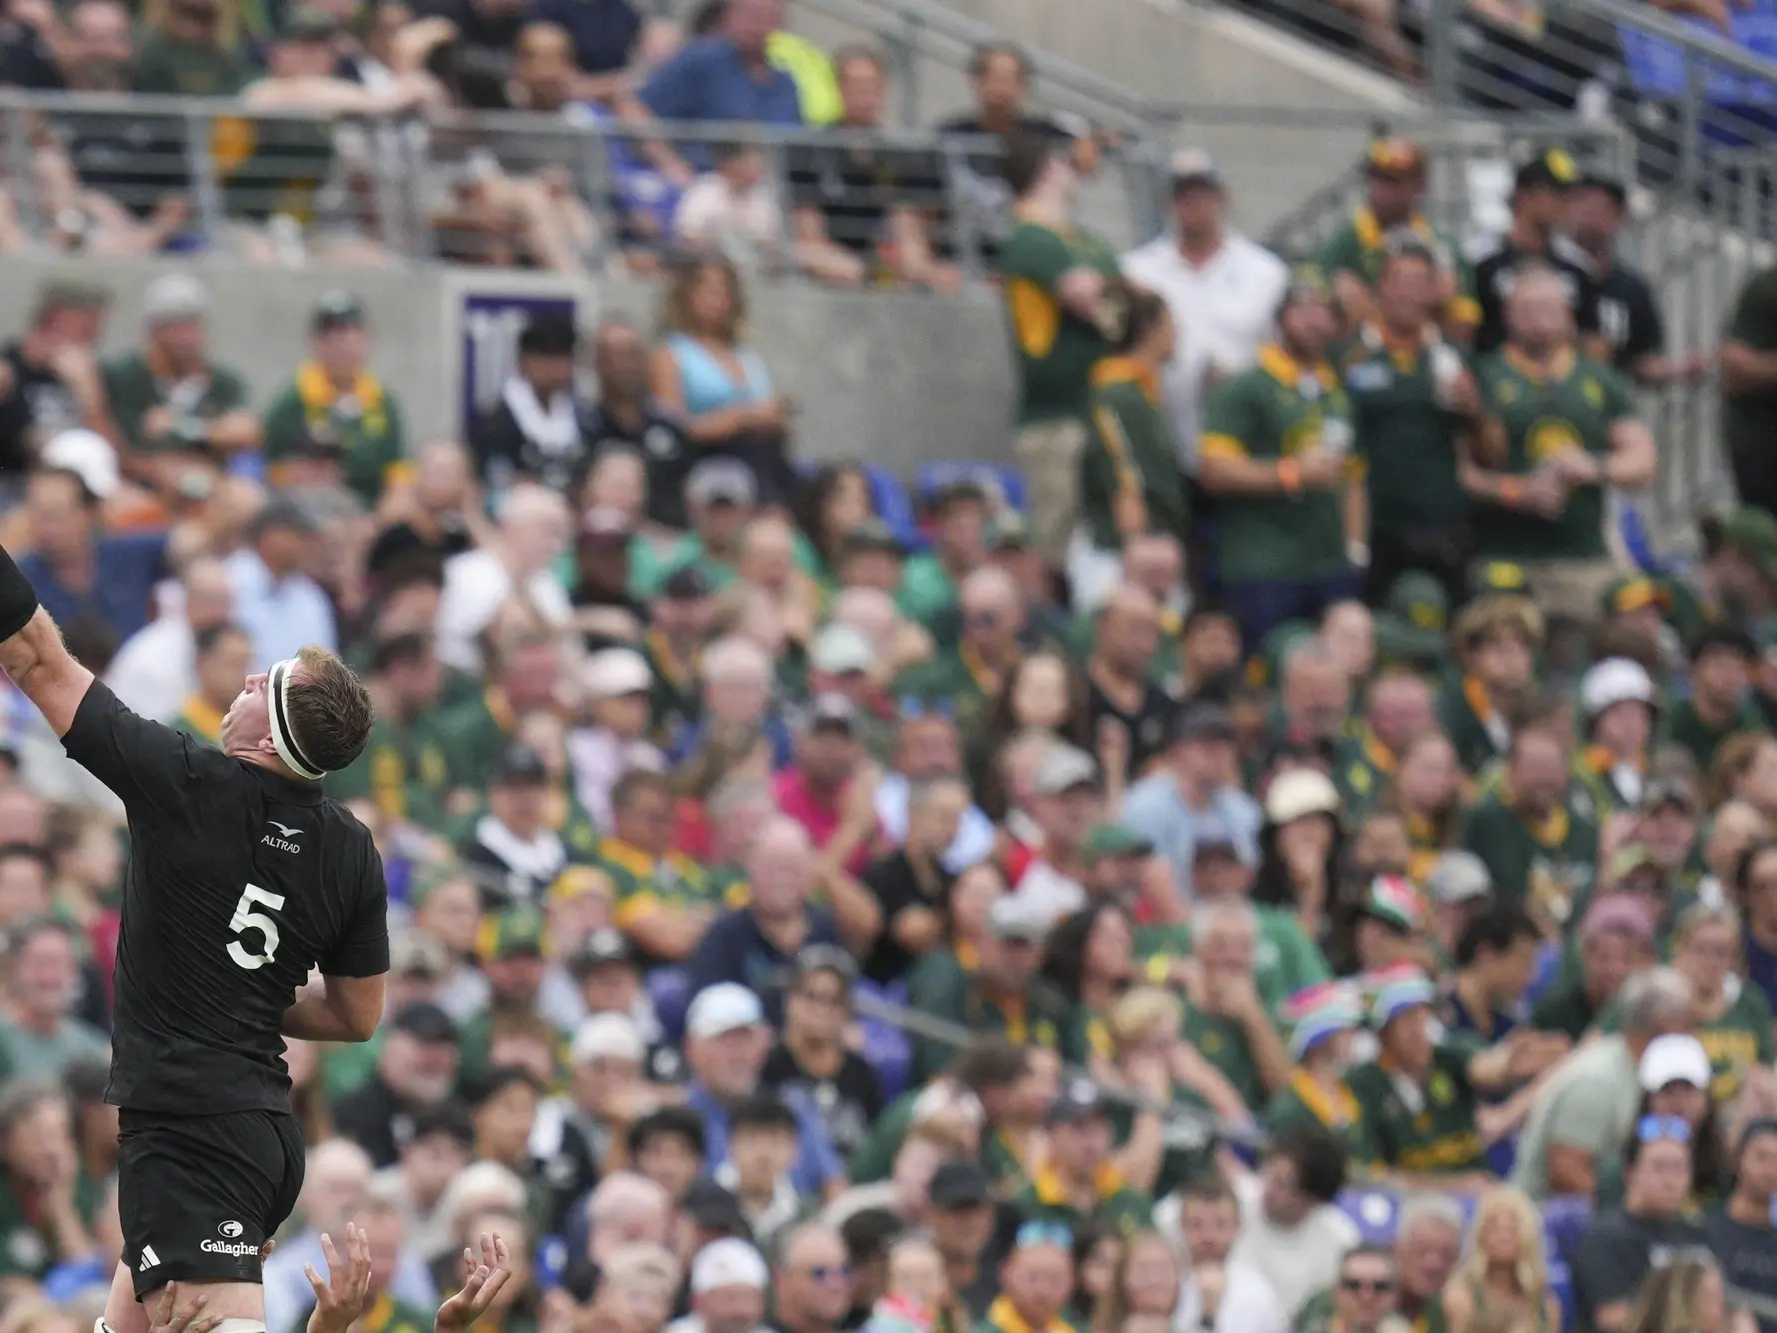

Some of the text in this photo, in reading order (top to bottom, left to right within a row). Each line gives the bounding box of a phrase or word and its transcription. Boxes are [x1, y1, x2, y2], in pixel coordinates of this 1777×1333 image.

[261, 834, 301, 854] ALTRAD
[226, 883, 285, 970] 5
[200, 1239, 259, 1257] Gallagher
